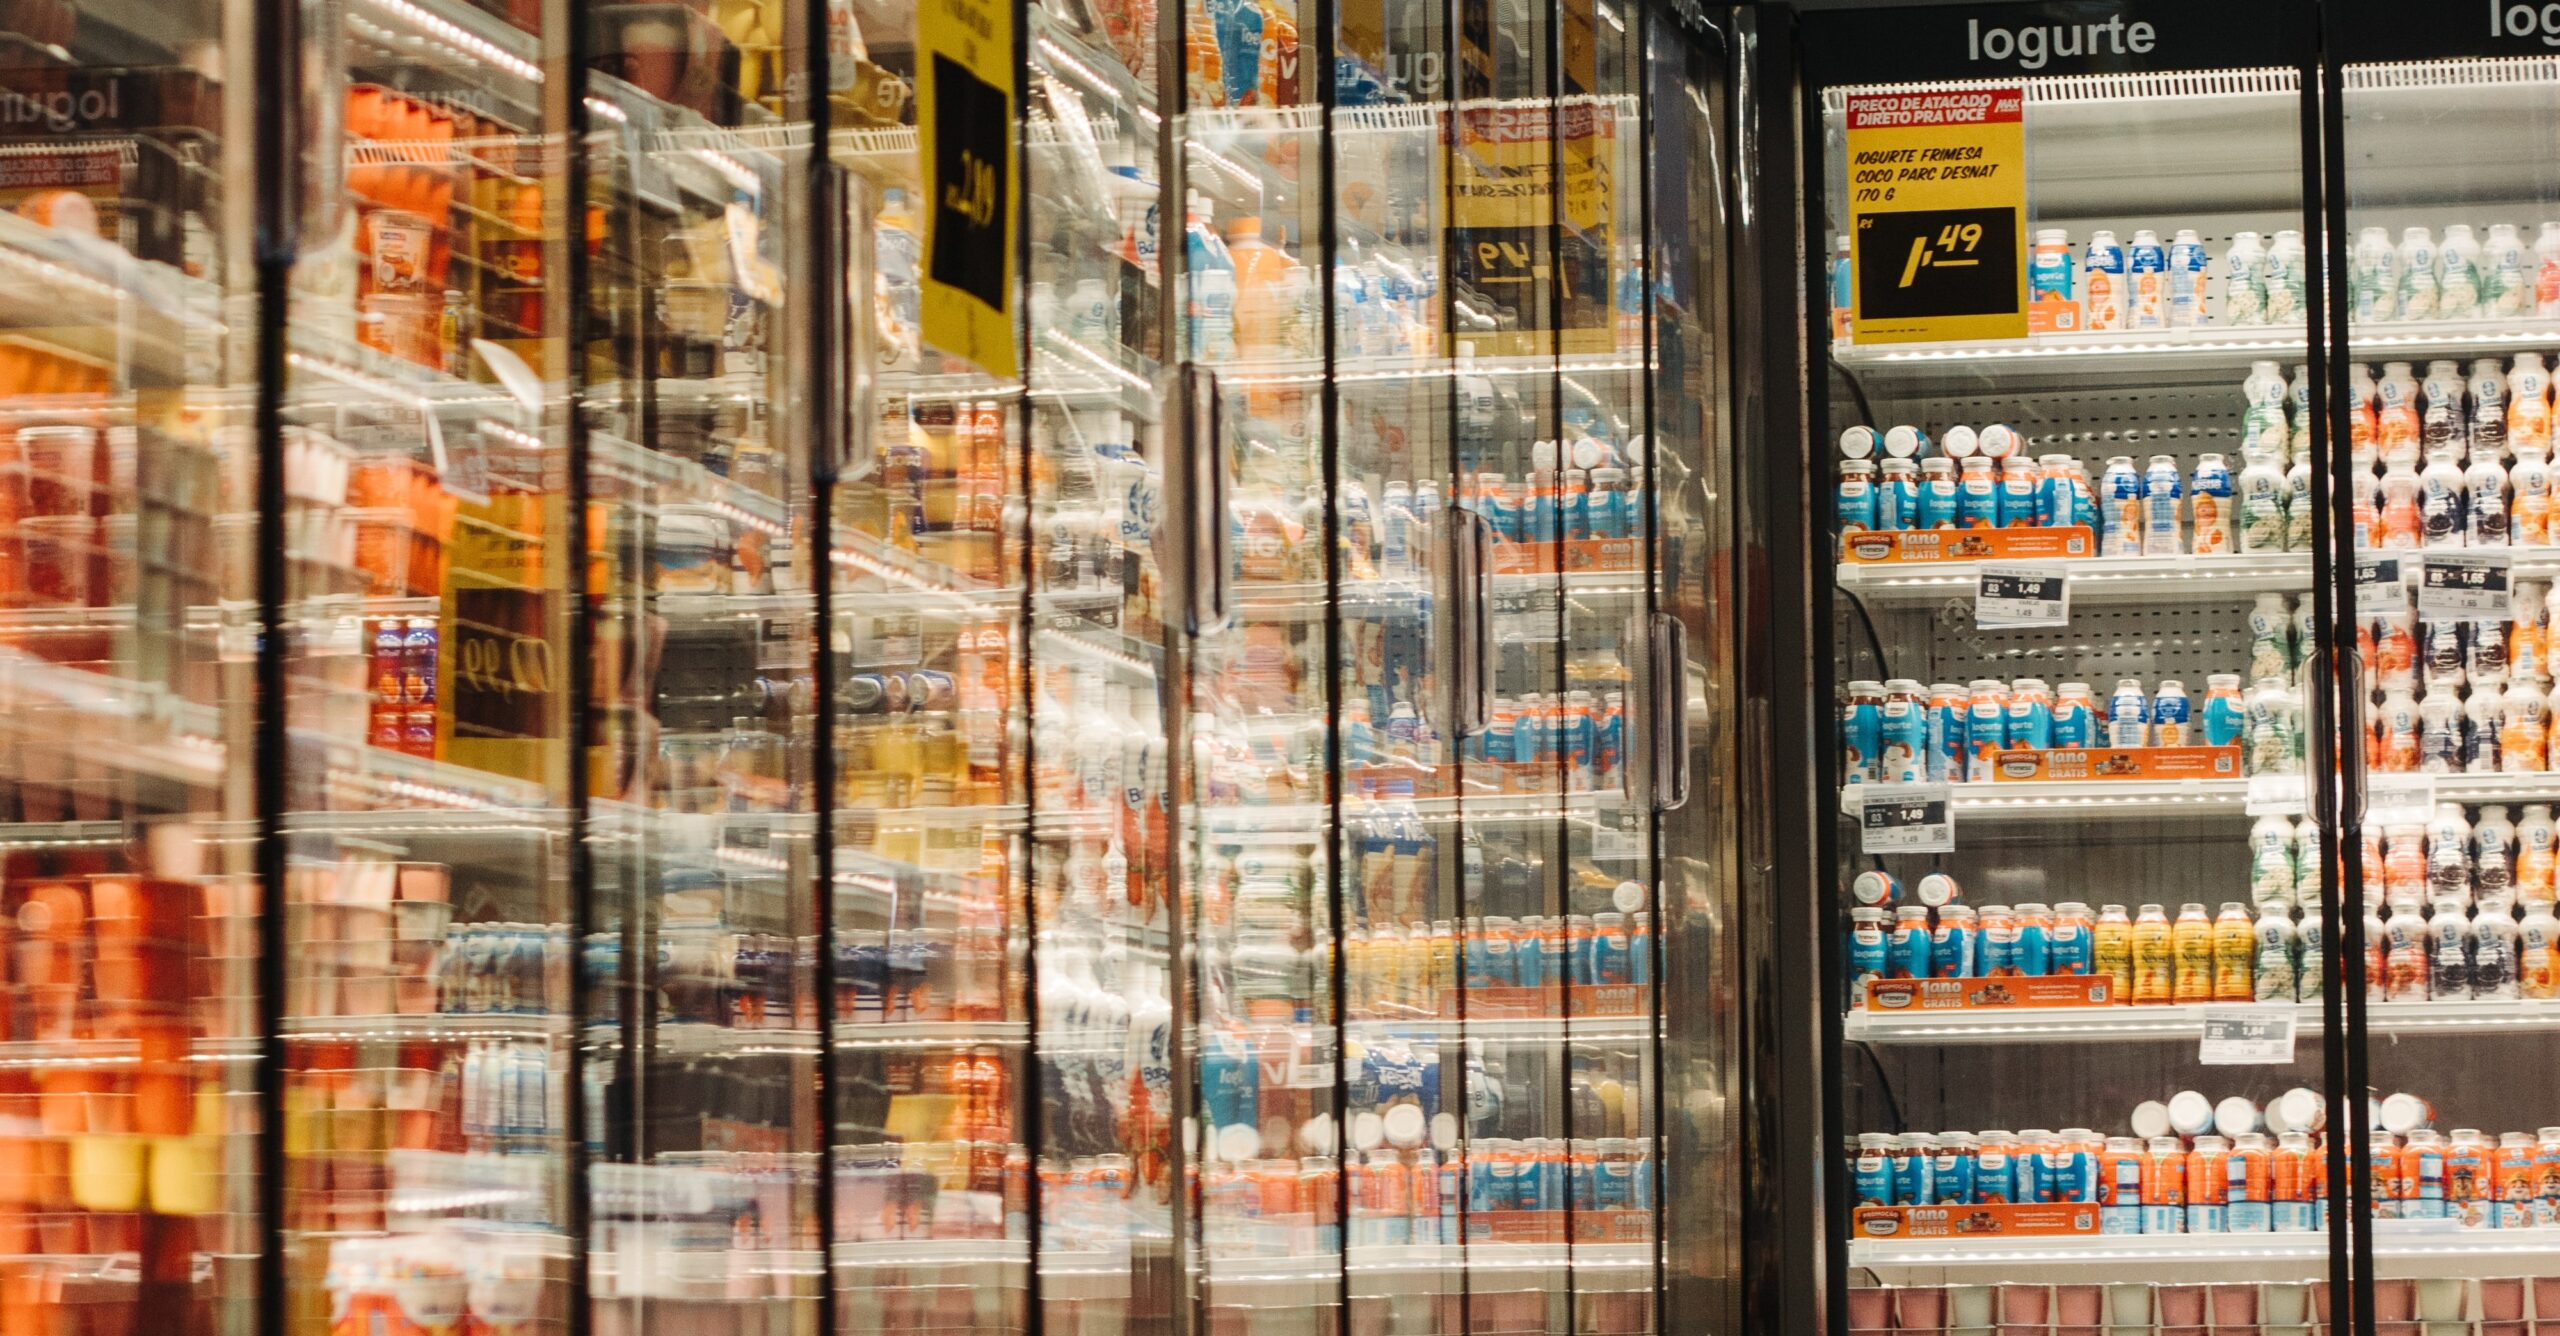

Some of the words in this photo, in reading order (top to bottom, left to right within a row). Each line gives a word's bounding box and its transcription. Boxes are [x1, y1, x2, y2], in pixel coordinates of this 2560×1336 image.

[1968, 14, 2156, 69] Iogurte
[1849, 98, 1898, 115] PREÇO
[1901, 97, 1920, 110] DE
[1922, 94, 1992, 109] ATACADO
[1856, 111, 1912, 125] DIRETO
[1913, 110, 1944, 122] PRA
[1855, 149, 1918, 165] IOGURTE
[1920, 147, 1983, 162] FRIMESA
[1856, 169, 1893, 183] COCO
[1898, 167, 1938, 181] PARC
[1941, 164, 1999, 179] DESNAT
[1856, 188, 1880, 201] 170
[1885, 187, 1896, 200] G
[2461, 572, 2485, 585] 1,65
[2018, 583, 2041, 595] 1,49
[1900, 808, 1924, 821] 1,49
